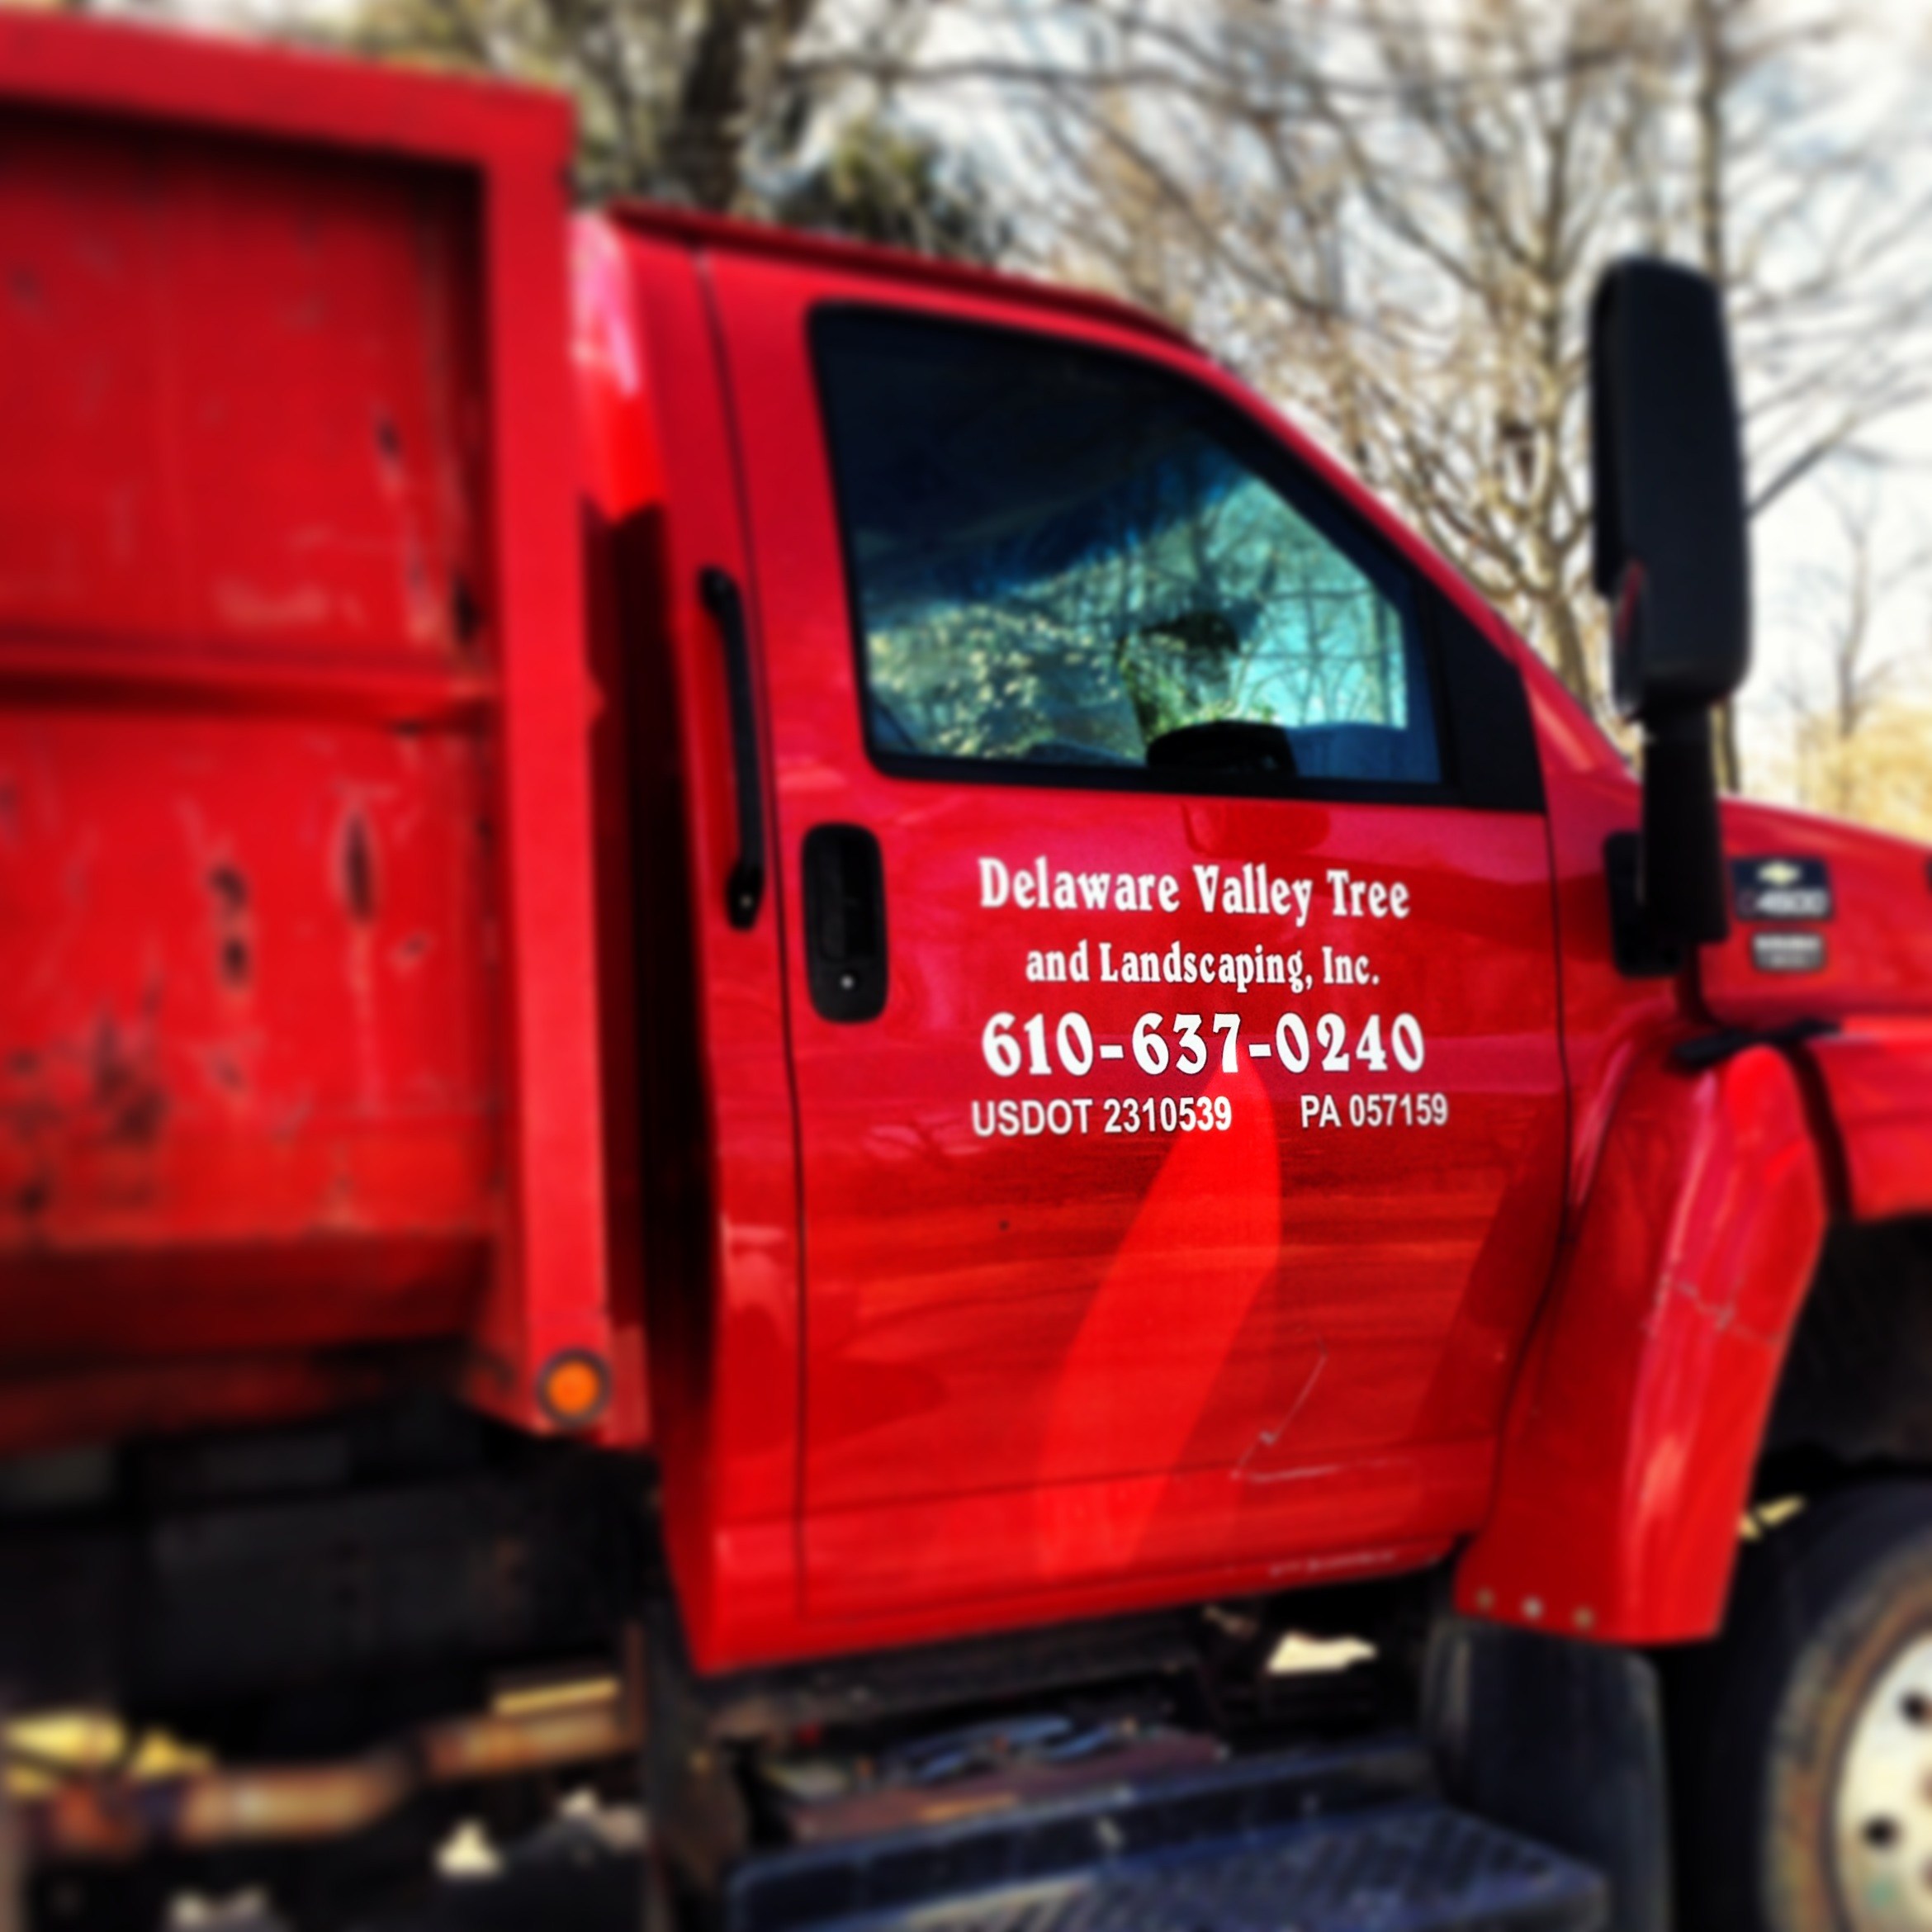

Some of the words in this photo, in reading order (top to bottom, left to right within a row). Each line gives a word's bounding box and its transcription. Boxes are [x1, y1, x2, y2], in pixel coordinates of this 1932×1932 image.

[978, 855, 1181, 913] Delaware
[1191, 862, 1313, 928] Valley
[1326, 869, 1409, 919] Tree
[1025, 939, 1091, 983] and
[1098, 940, 1314, 995] Landscaping,
[1321, 945, 1380, 986] Inc.
[981, 1011, 1425, 1077] 610-637-0240
[971, 1097, 1094, 1137] USDOT
[1102, 1096, 1234, 1134] 2310539
[1300, 1094, 1342, 1129] PA
[1348, 1092, 1449, 1127] 057159
